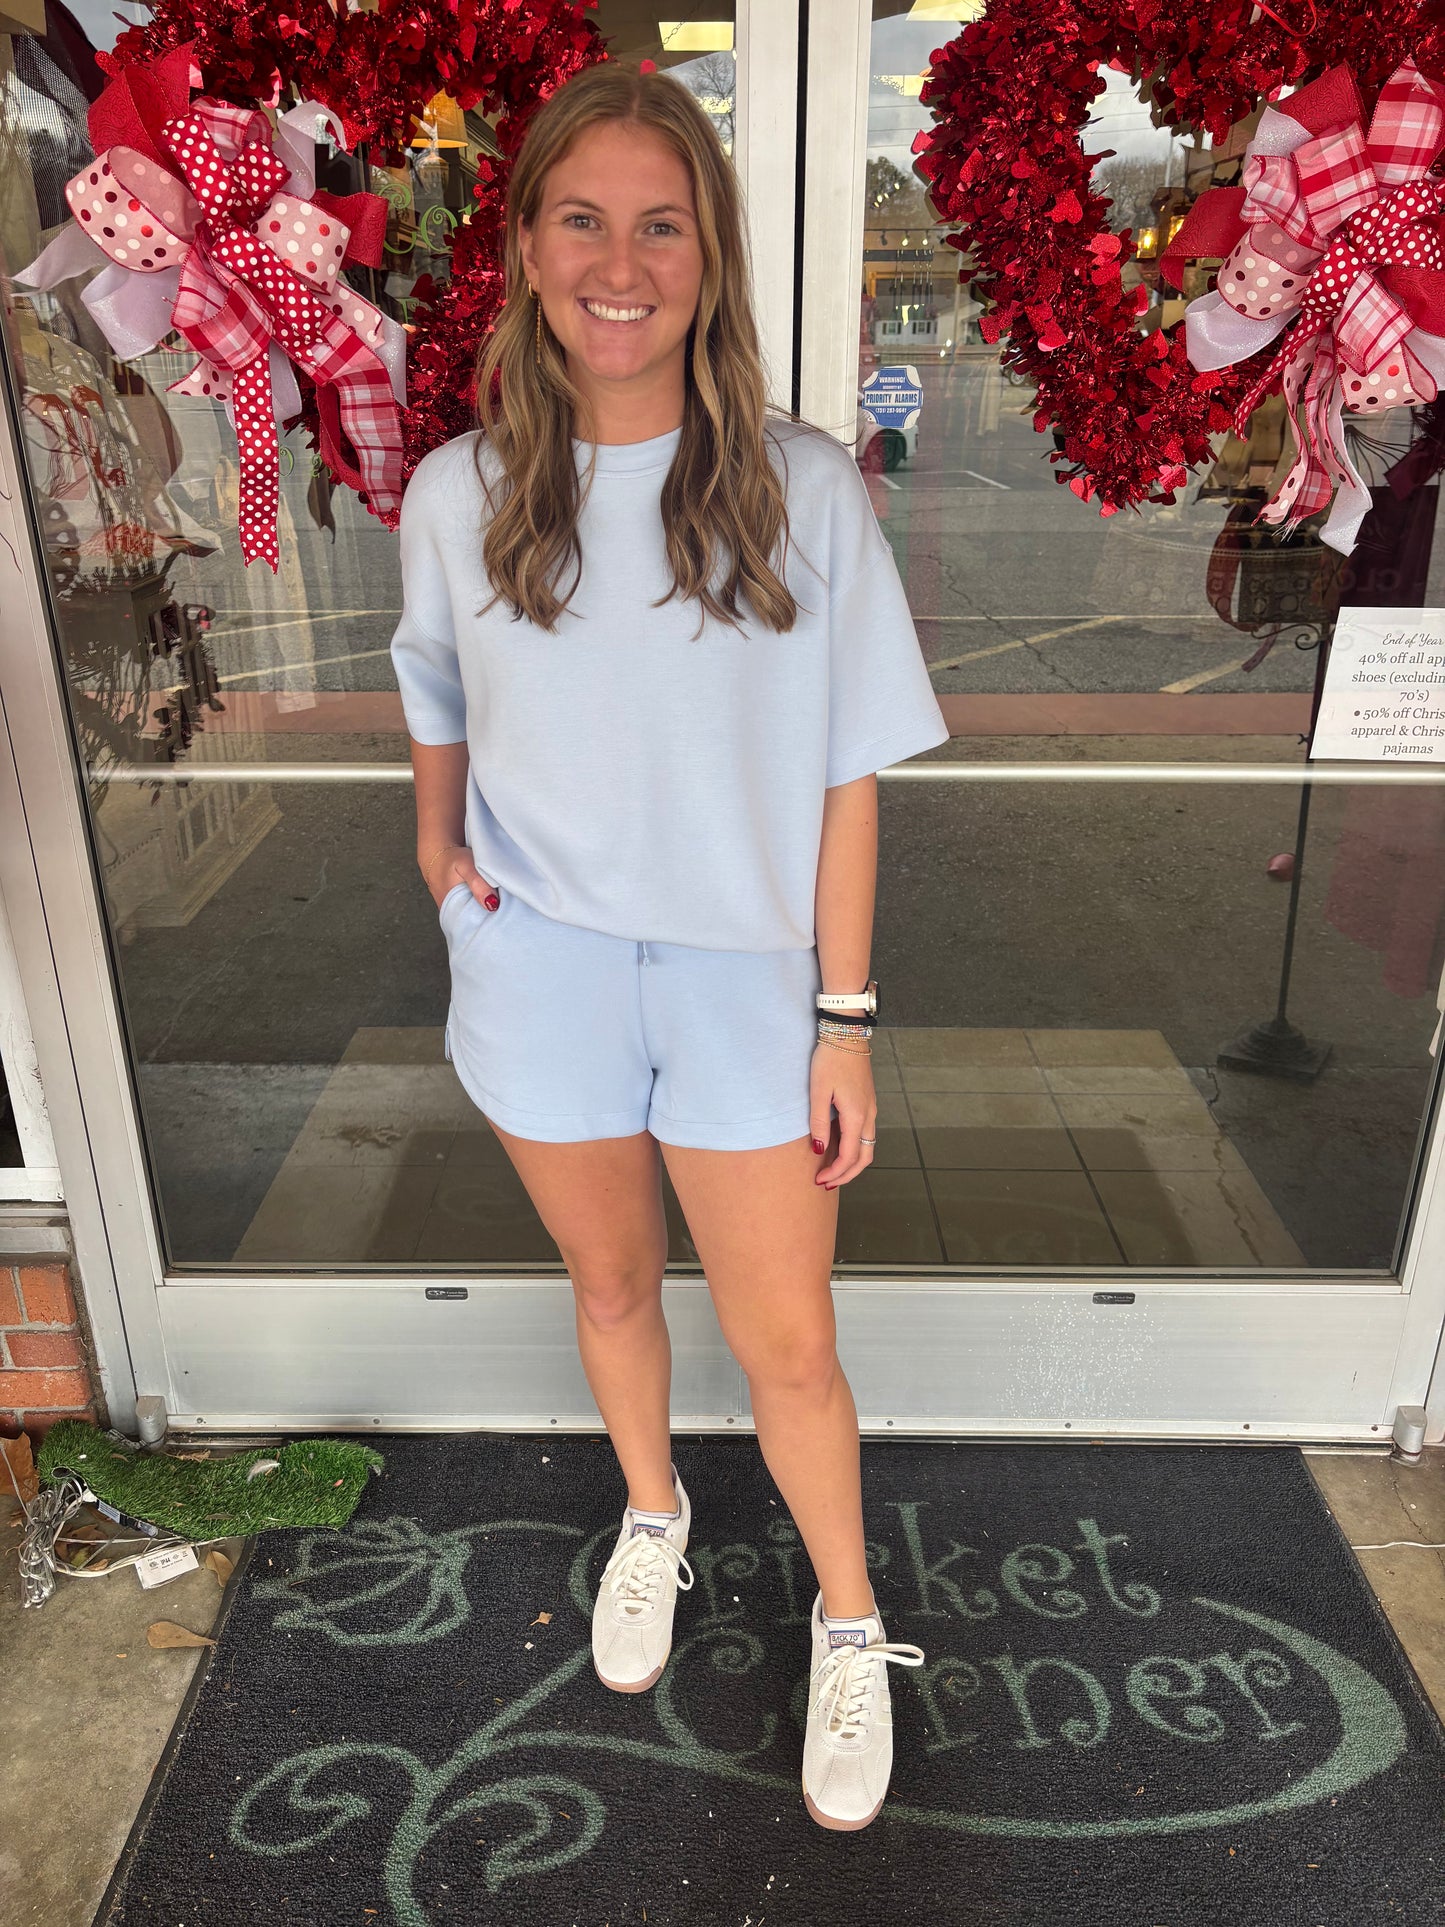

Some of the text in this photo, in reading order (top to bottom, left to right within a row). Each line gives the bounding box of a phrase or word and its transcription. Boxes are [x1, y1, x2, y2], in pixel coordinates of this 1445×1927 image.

[866, 393, 918, 404] PRIORITY ALARMS
[1382, 632, 1444, 648] End of Year
[1358, 652, 1388, 666] 40%
[1390, 651, 1409, 664] off
[1409, 651, 1425, 664] all
[1351, 670, 1387, 683] shoes
[1362, 707, 1391, 721] 50%
[1392, 706, 1412, 719] off
[1350, 724, 1396, 738] apparel
[1398, 725, 1410, 737] &
[1382, 742, 1434, 756] pajamas
[653, 1627, 1305, 1760] Crner
